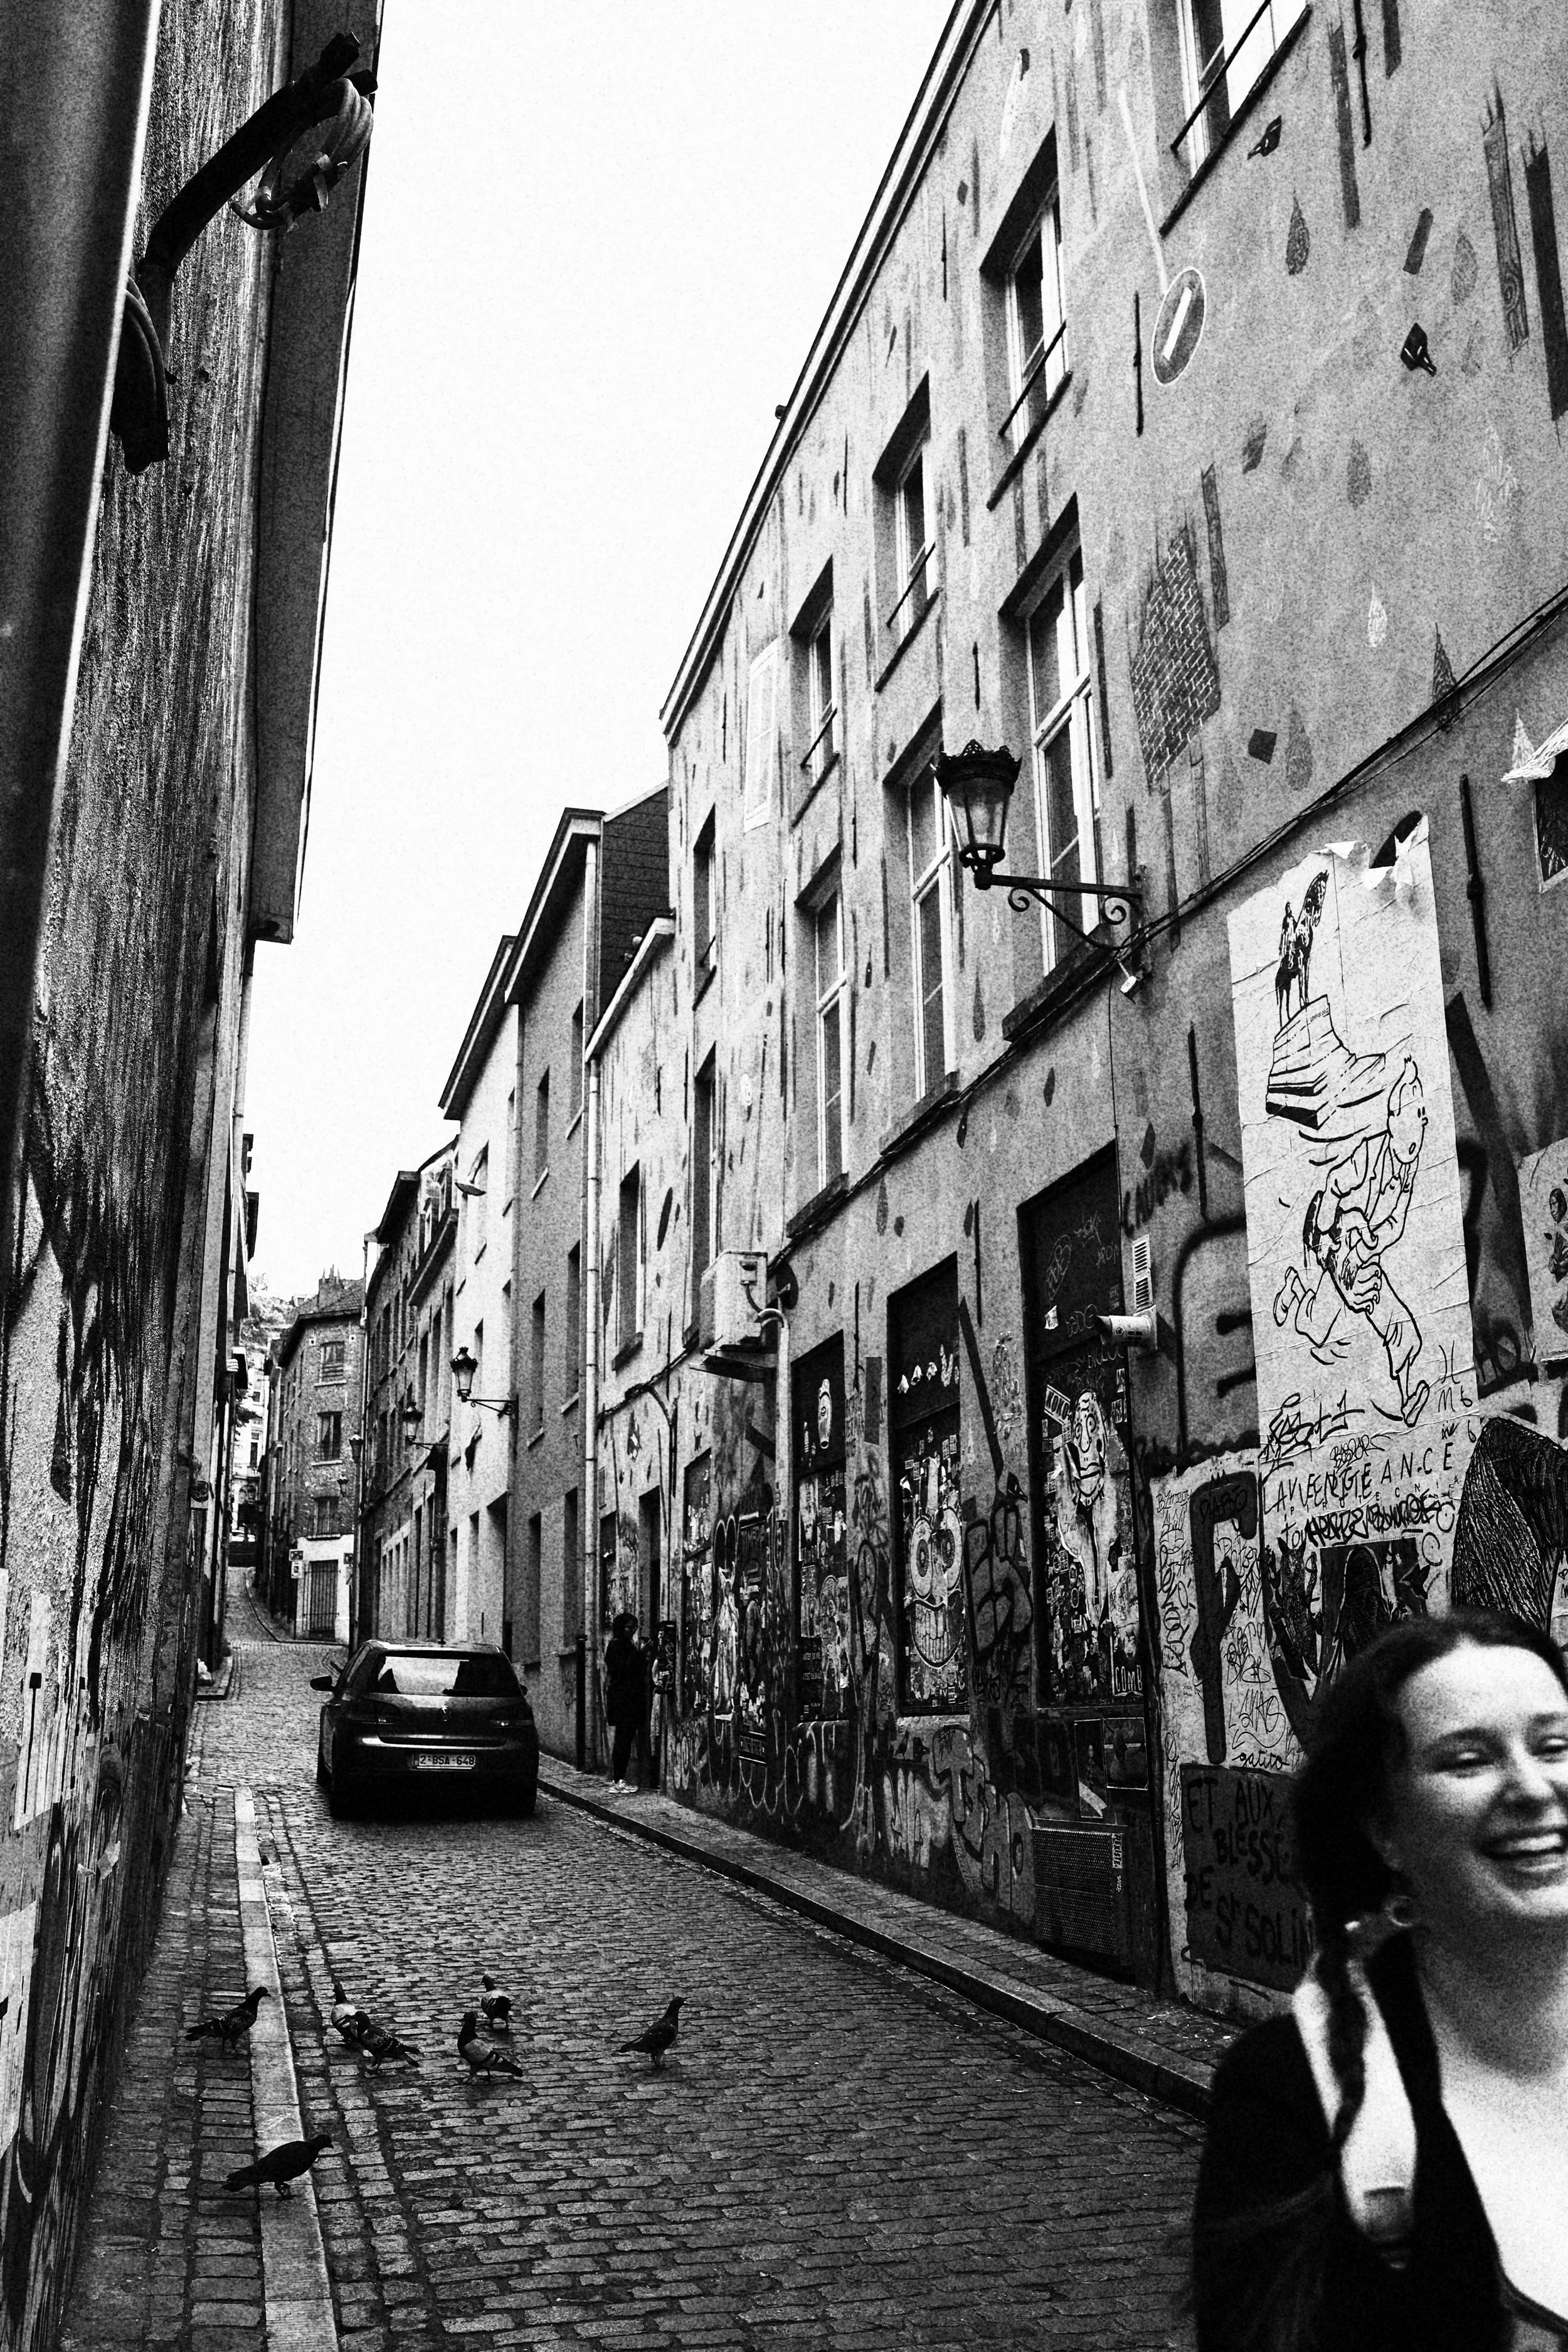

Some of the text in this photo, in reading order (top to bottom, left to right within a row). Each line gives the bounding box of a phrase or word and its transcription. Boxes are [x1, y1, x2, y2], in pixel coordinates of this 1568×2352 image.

[420, 1755, 475, 1766] 2-BSA-648
[1231, 1749, 1290, 1775] gatito
[1236, 1780, 1274, 1826] AUX
